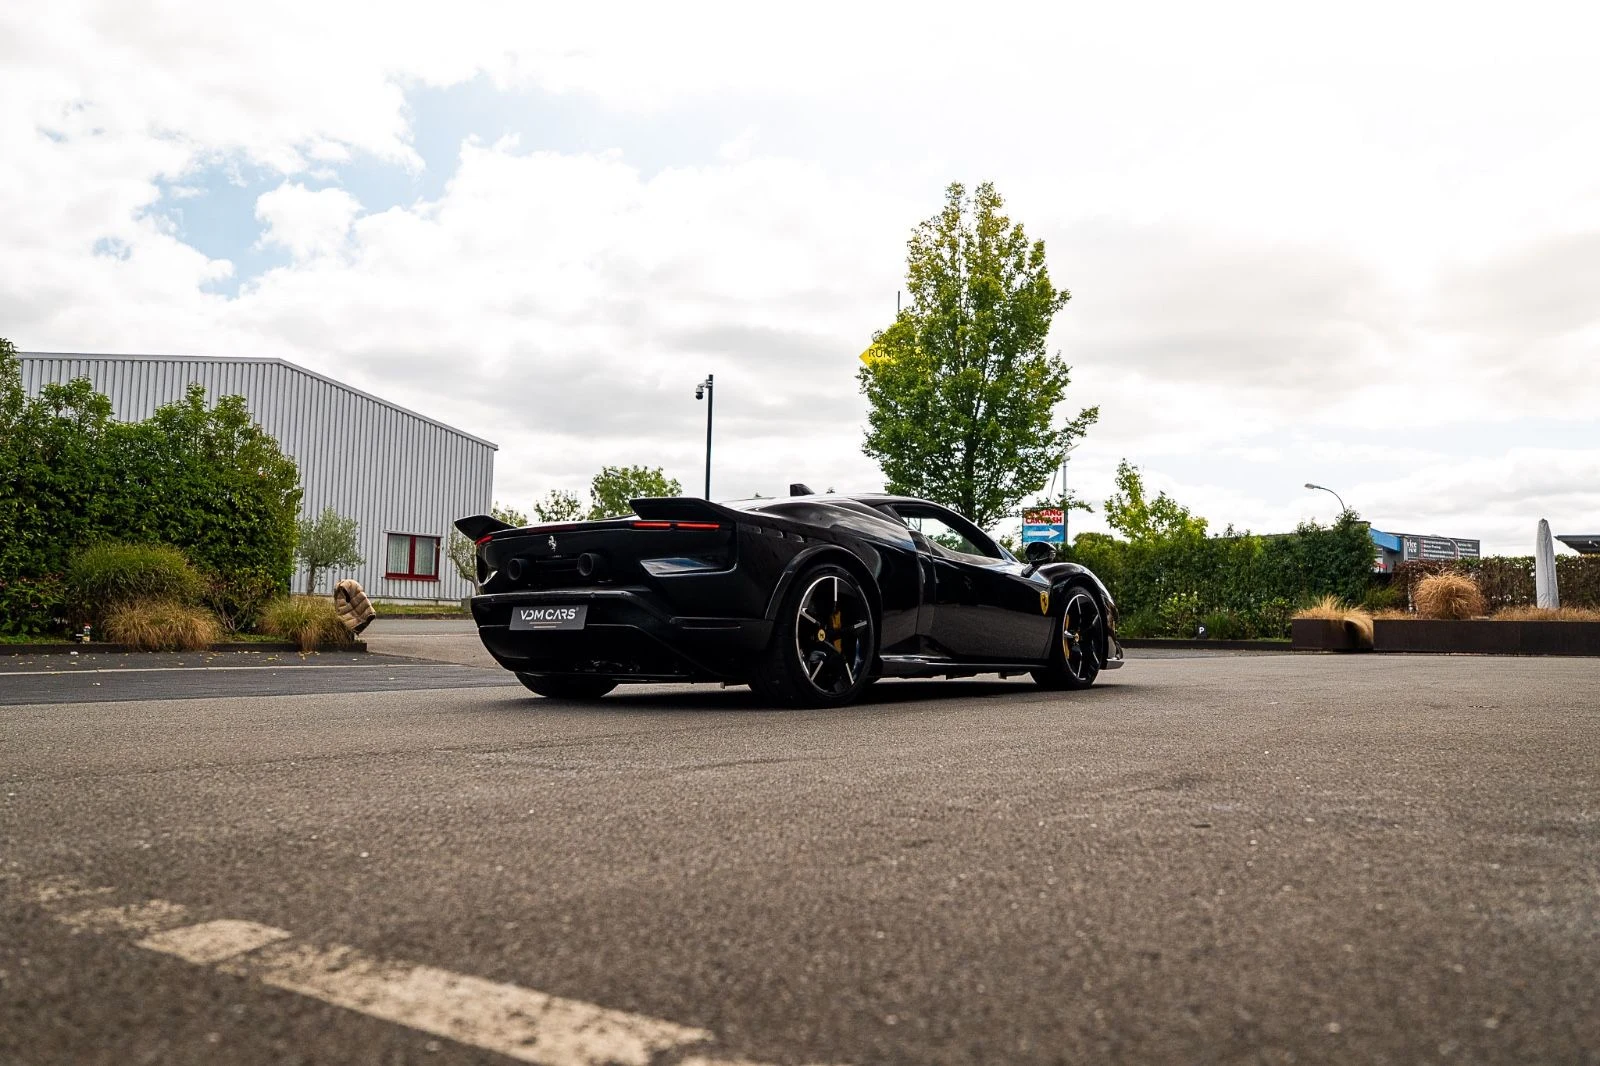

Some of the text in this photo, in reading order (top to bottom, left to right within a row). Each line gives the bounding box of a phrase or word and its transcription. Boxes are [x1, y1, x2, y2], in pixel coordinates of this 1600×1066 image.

[1025, 516, 1062, 524] CARWSH
[545, 608, 576, 620] CARS
[1198, 626, 1205, 634] P
